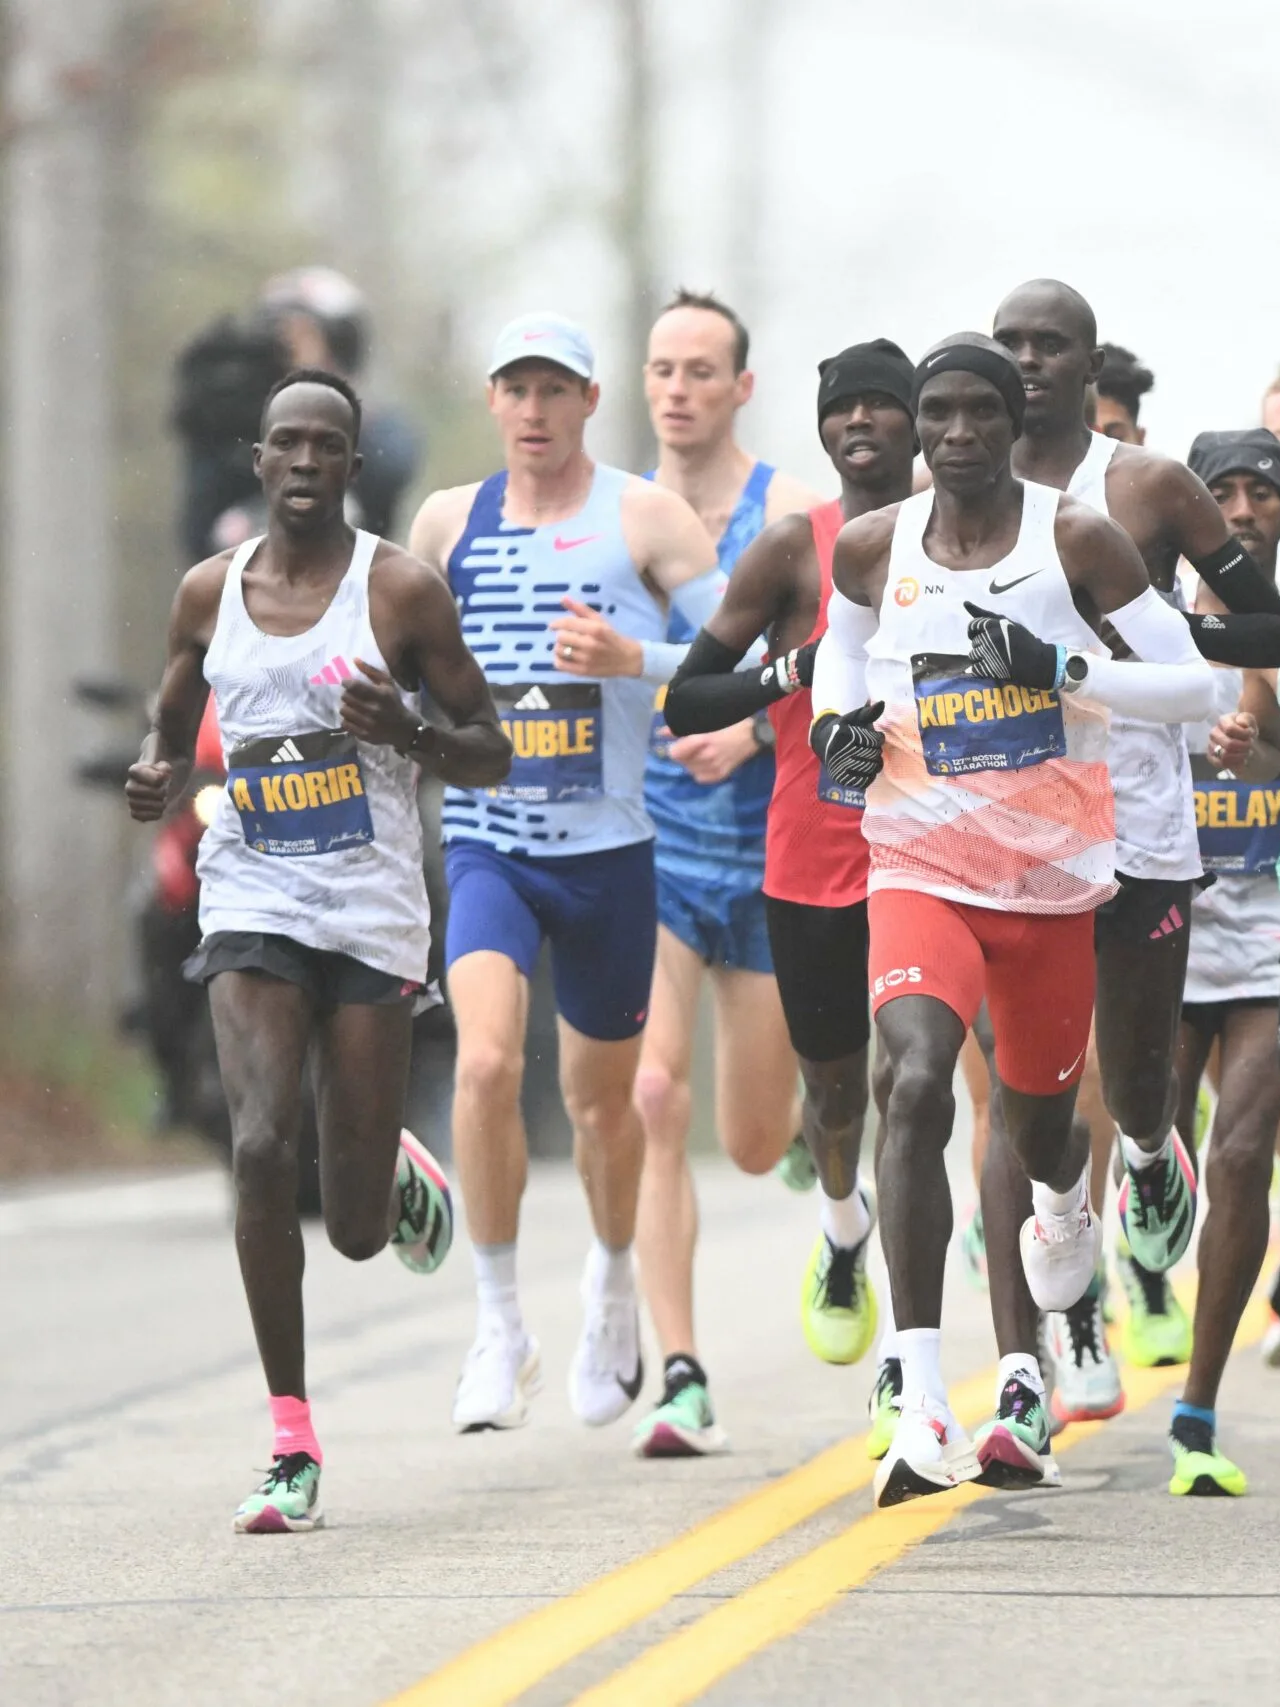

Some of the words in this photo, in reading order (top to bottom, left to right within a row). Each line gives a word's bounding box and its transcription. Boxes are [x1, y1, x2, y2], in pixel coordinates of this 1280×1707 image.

[925, 585, 944, 594] NN
[919, 684, 1058, 728] KIPCHOGE
[972, 753, 1006, 761] BOSTON
[954, 761, 1008, 772] MARATHON
[233, 778, 256, 812] A
[260, 763, 363, 813] KORIR
[269, 846, 316, 854] MARATHON
